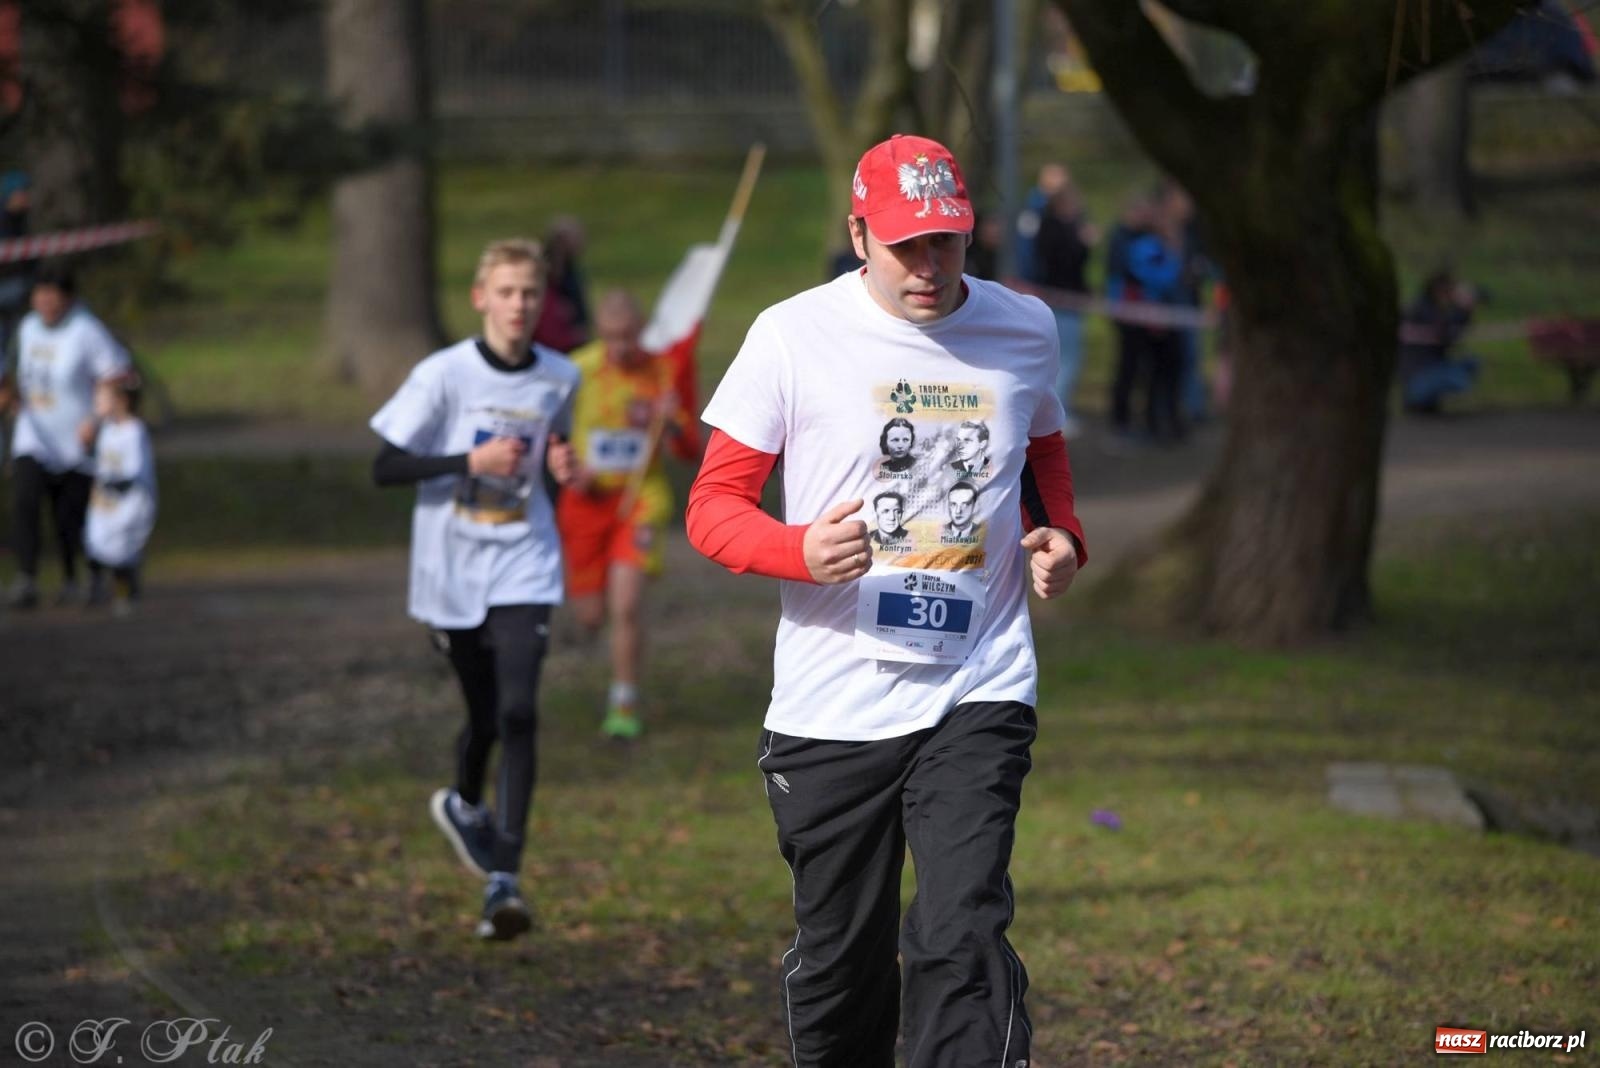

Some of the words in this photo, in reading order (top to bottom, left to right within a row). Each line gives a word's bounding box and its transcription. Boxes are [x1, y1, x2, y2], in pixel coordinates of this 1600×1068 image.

[919, 385, 949, 394] TROPEM
[921, 395, 978, 409] WILCZYM
[879, 544, 912, 554] Kontrym
[921, 581, 956, 593] WILCZYM
[907, 596, 948, 628] 30
